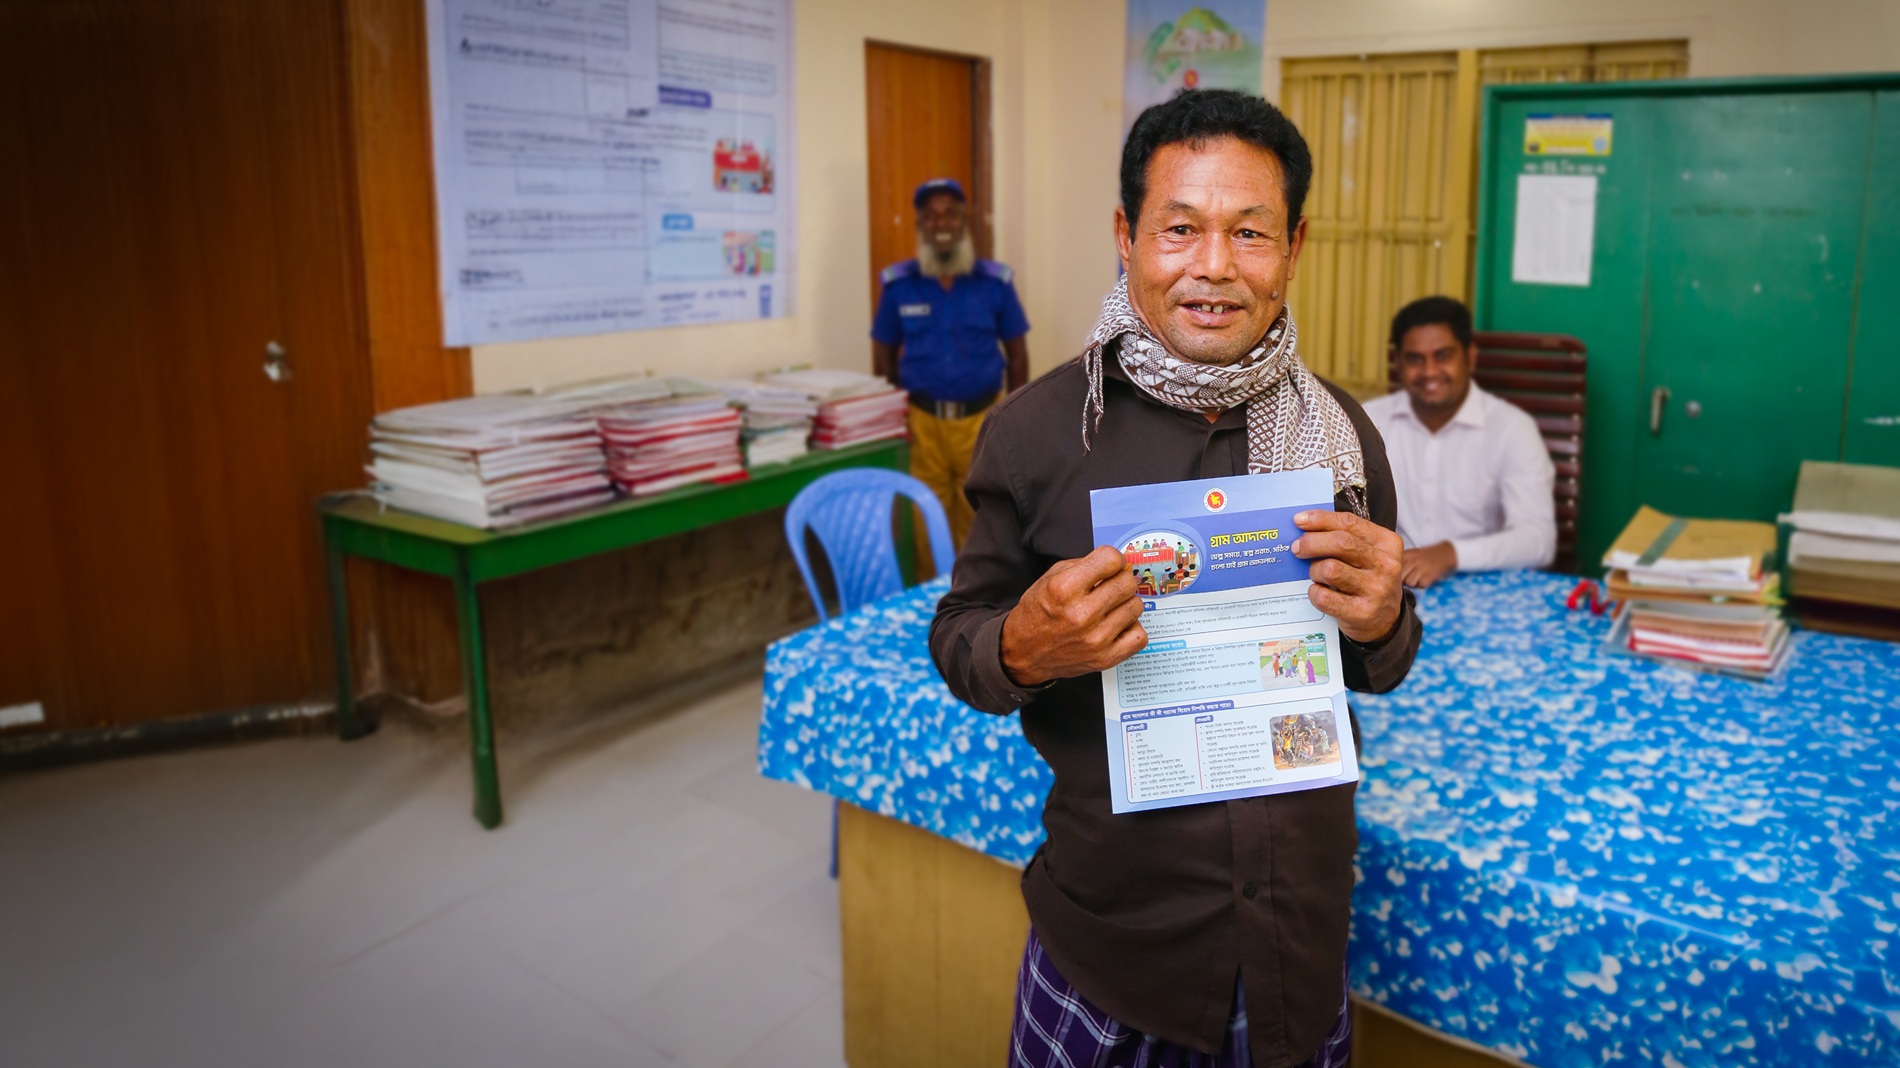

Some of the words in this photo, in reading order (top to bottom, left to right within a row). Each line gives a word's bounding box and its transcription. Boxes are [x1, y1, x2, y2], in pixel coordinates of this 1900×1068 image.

[1209, 534, 1231, 548] গ্রাম
[1232, 528, 1279, 545] আদালত
[1211, 562, 1225, 570] চলো
[1226, 561, 1237, 569] যাই
[1249, 557, 1277, 566] আদালতে
